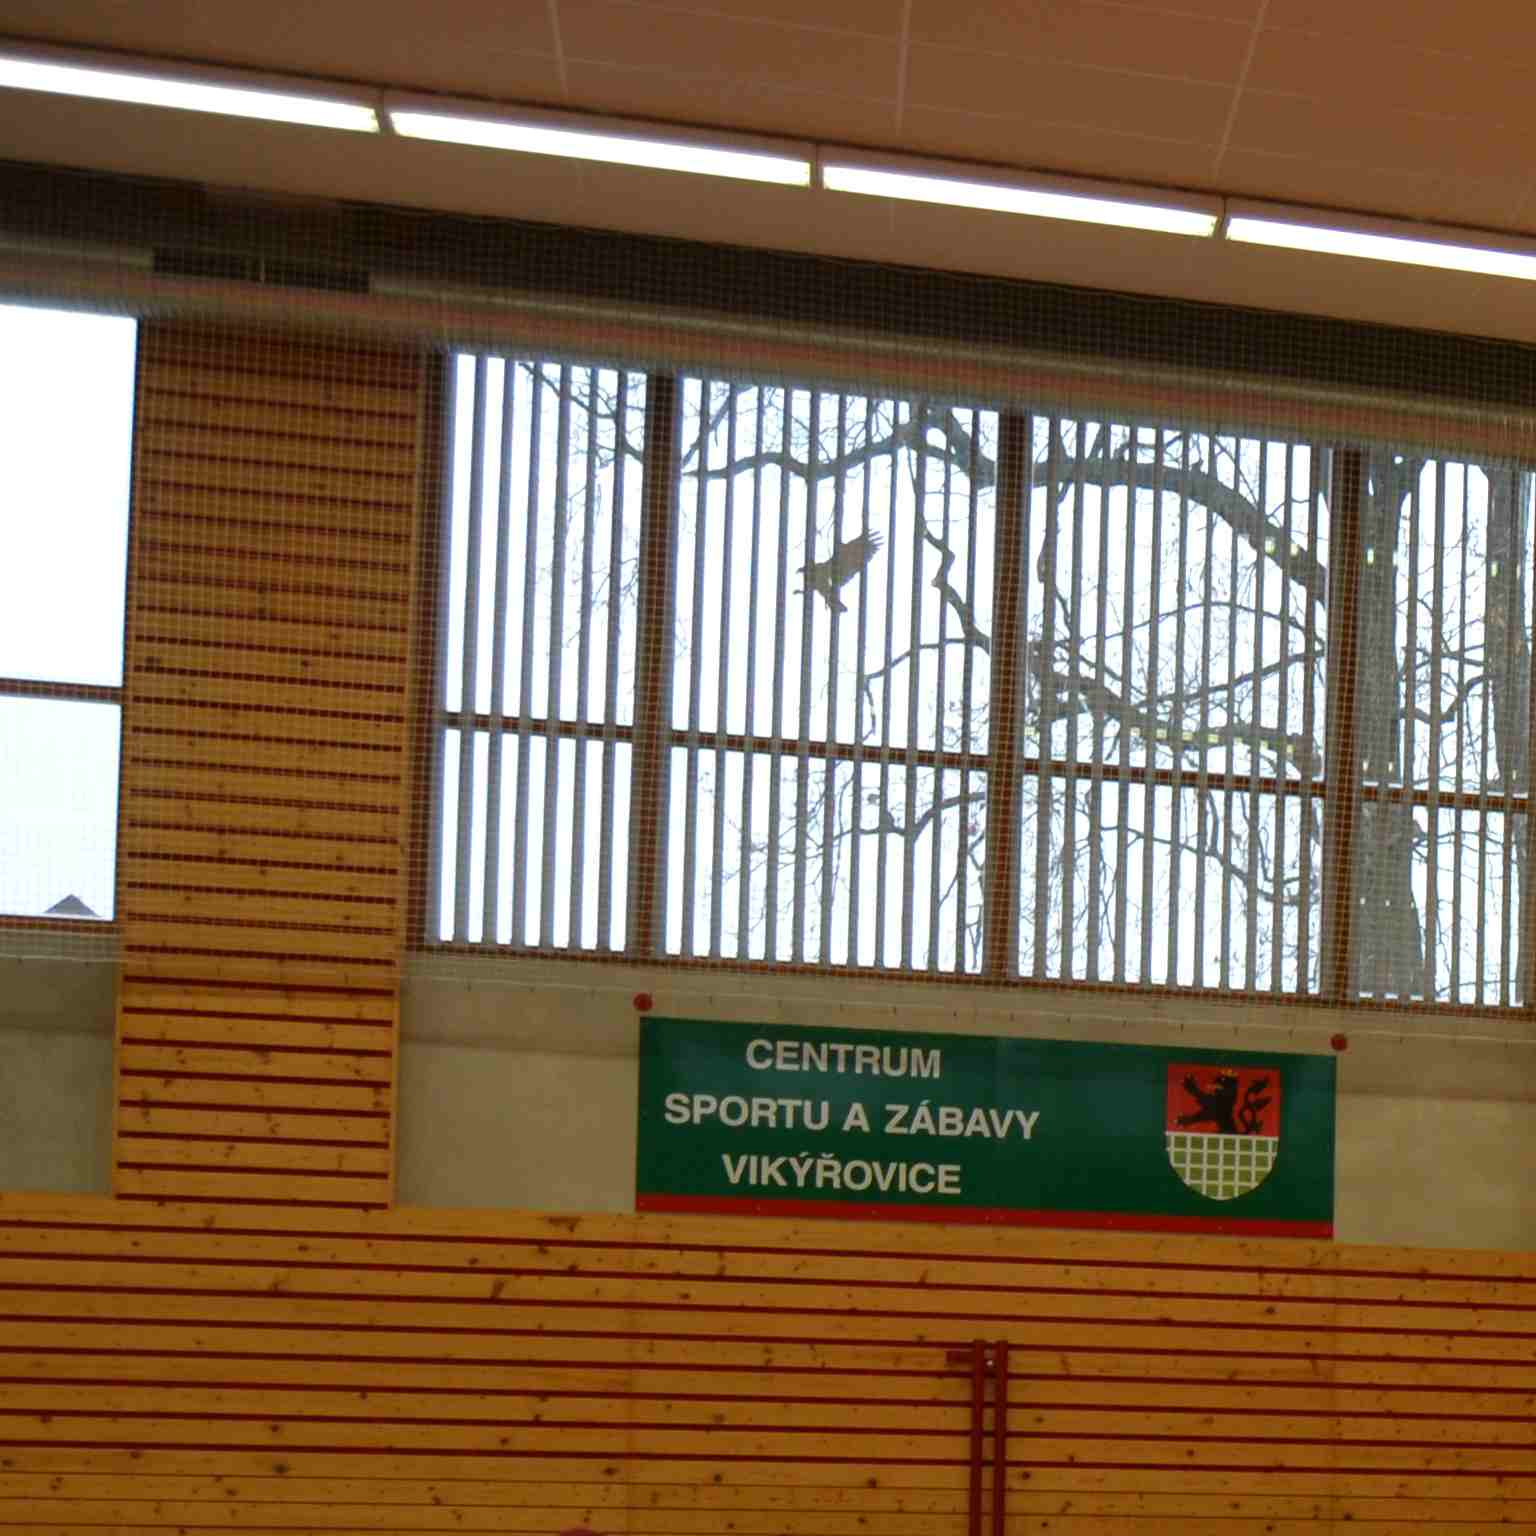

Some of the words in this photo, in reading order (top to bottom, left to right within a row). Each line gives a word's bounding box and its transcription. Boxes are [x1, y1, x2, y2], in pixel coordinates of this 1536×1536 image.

[745, 1038, 941, 1079] CENTRUM
[664, 1093, 829, 1130] SPORTU
[842, 1101, 870, 1132] A
[884, 1099, 1041, 1139] ZÁBAVY
[721, 1152, 962, 1193] VIKÝŘOVICE
